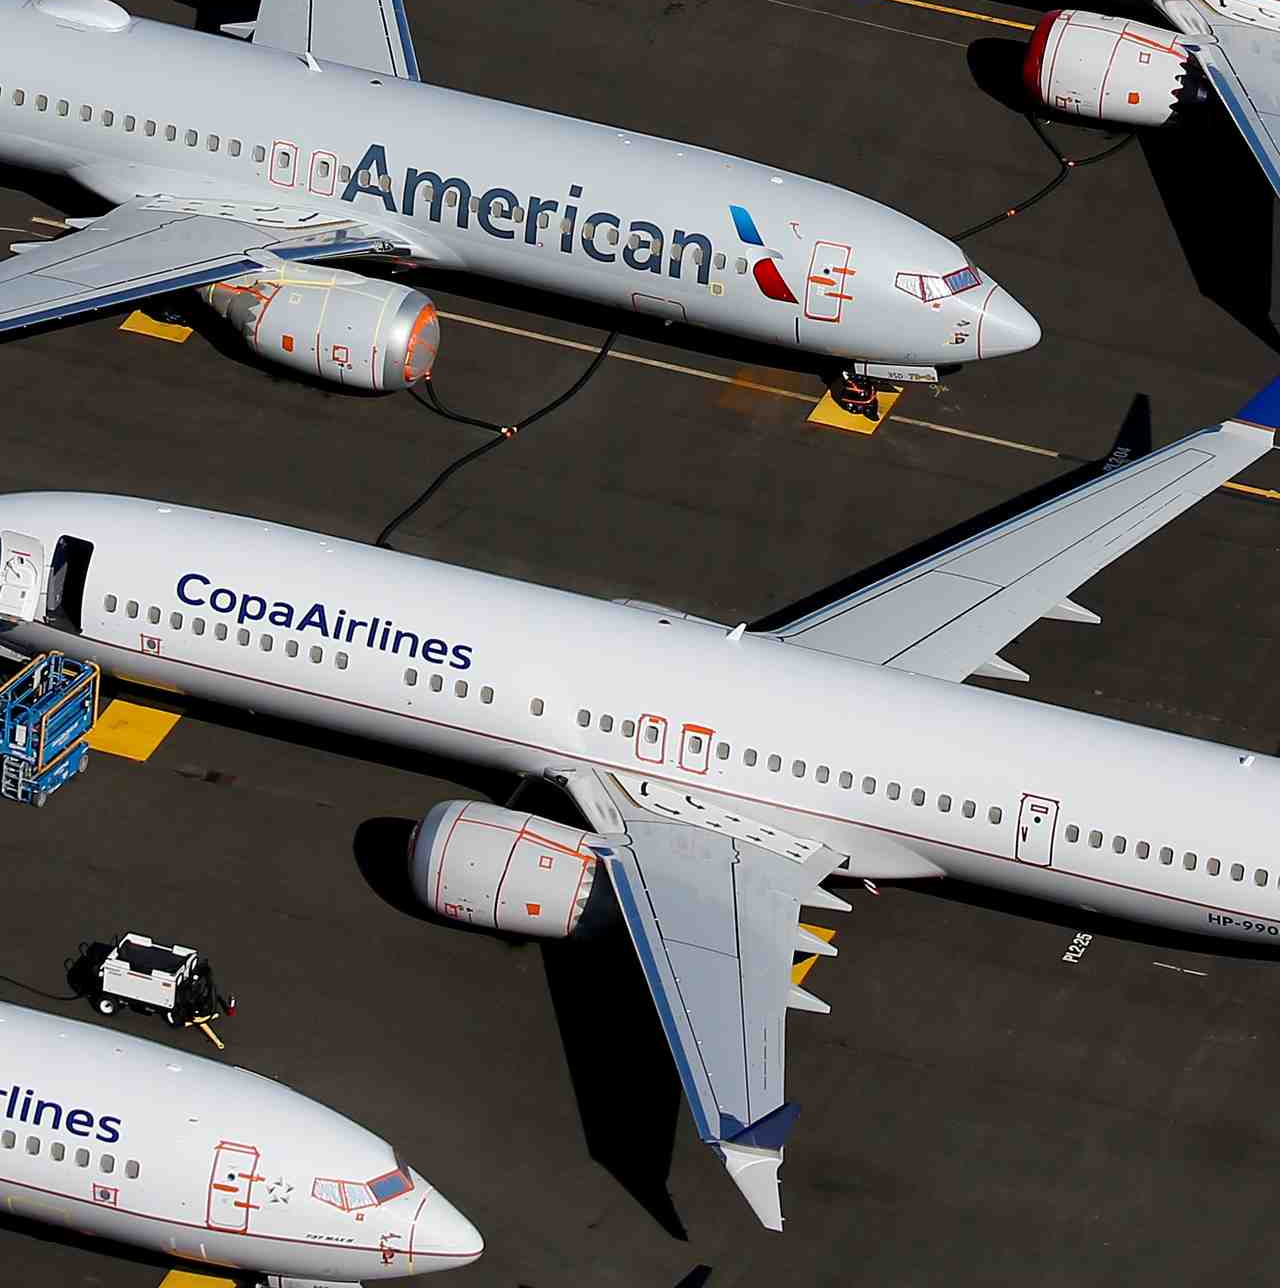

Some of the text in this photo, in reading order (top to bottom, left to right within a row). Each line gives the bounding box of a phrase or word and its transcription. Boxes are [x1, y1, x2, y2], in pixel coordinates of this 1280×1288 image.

[340, 143, 714, 286] American
[176, 572, 473, 671] CopaAirlines
[1061, 932, 1093, 964] PL2-25
